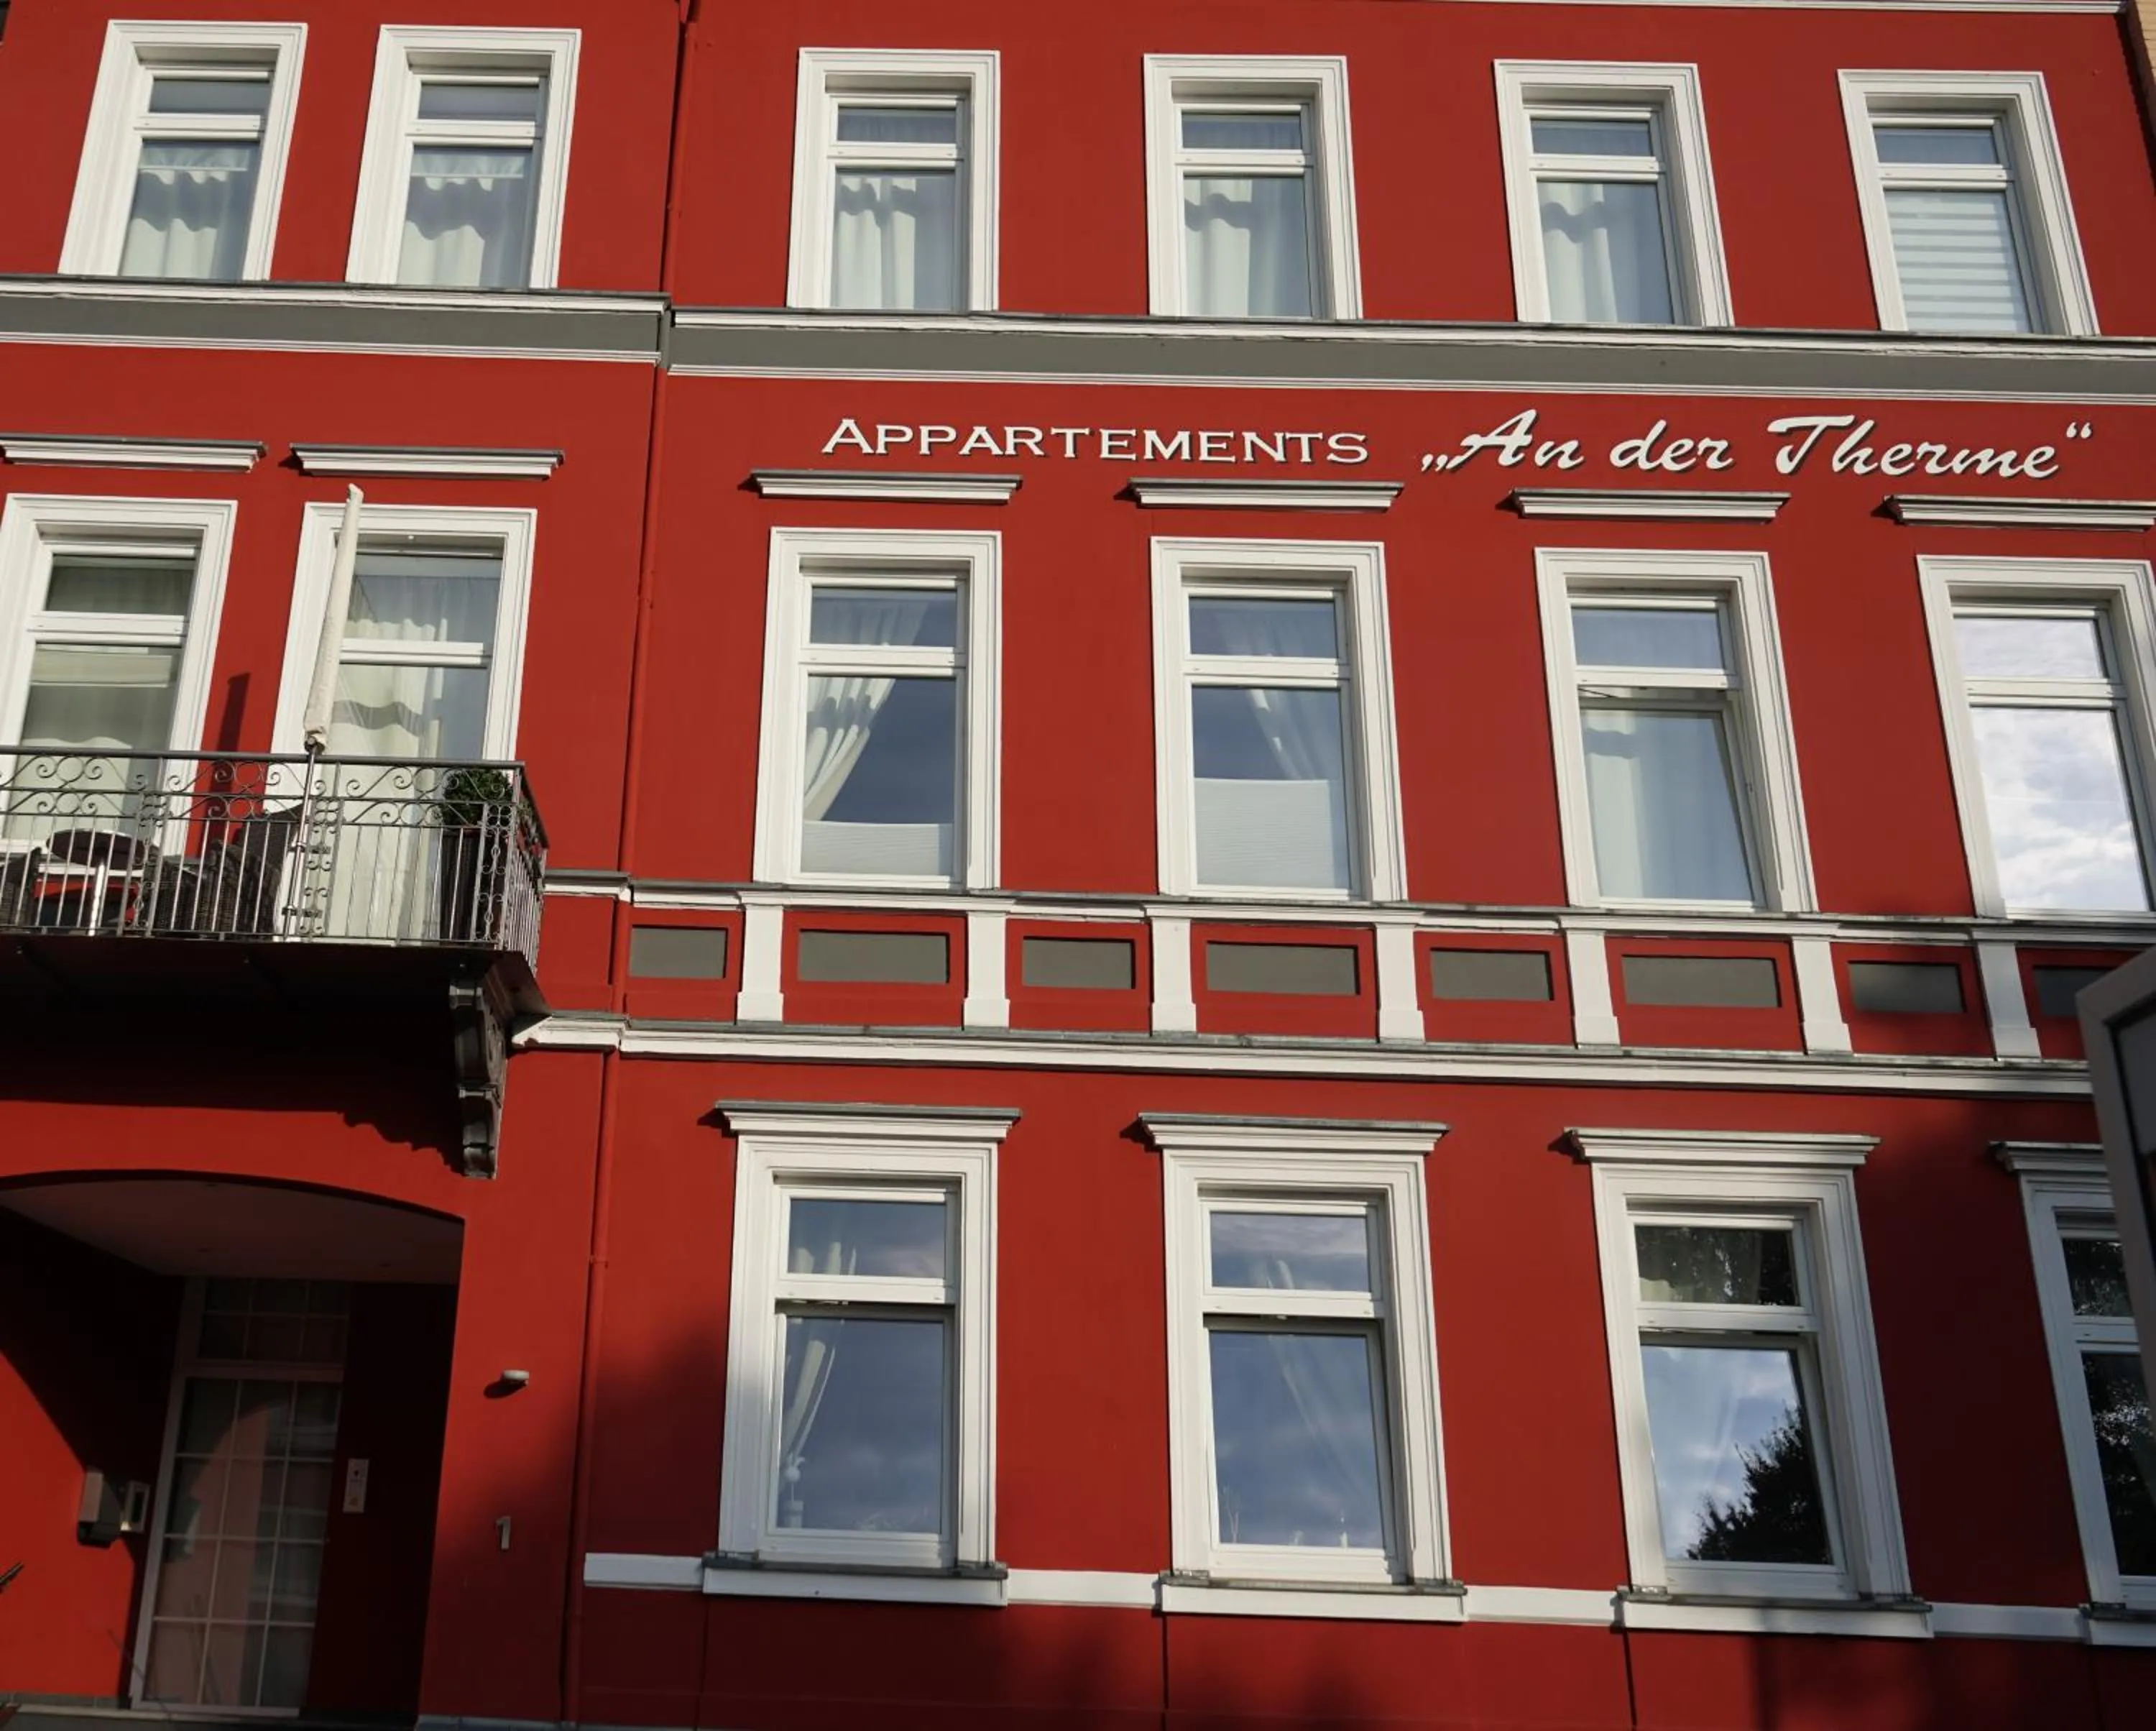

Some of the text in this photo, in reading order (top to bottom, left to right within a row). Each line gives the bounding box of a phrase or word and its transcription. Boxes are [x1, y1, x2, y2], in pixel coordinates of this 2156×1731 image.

[821, 418, 1369, 464] APPARTEMENTS
[1609, 418, 1733, 472] der
[496, 1515, 511, 1550] 1
